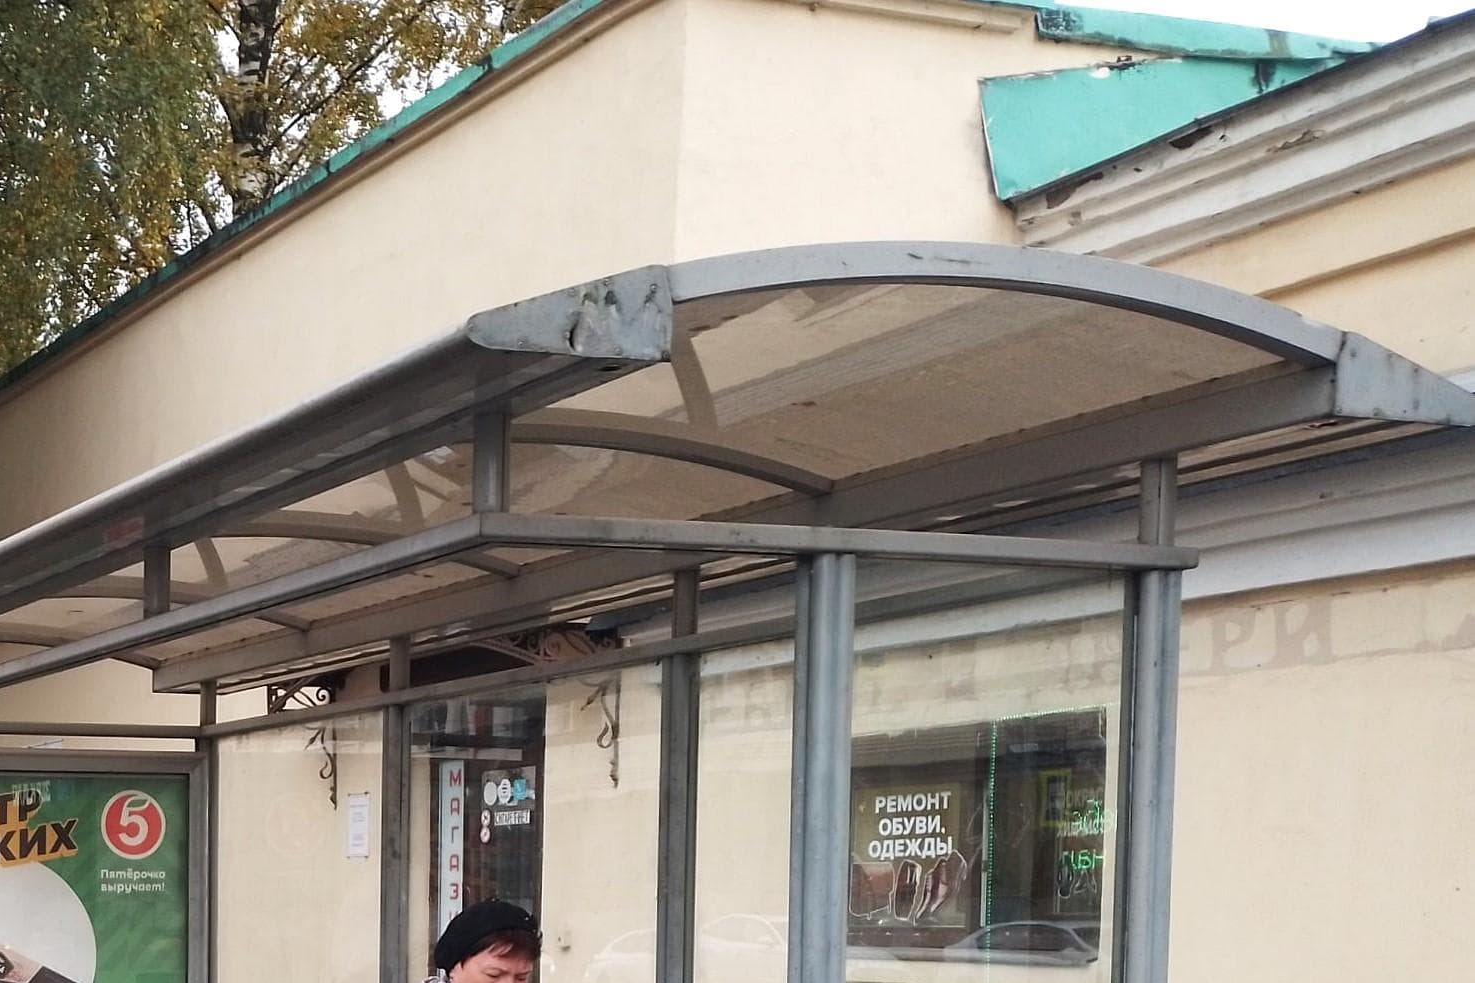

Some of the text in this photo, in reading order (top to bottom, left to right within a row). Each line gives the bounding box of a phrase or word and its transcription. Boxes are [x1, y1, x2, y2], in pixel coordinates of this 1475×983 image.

[874, 791, 953, 814] РЕМОНТ
[118, 795, 153, 847] 5
[868, 836, 953, 861] ОДЕЖДЫ
